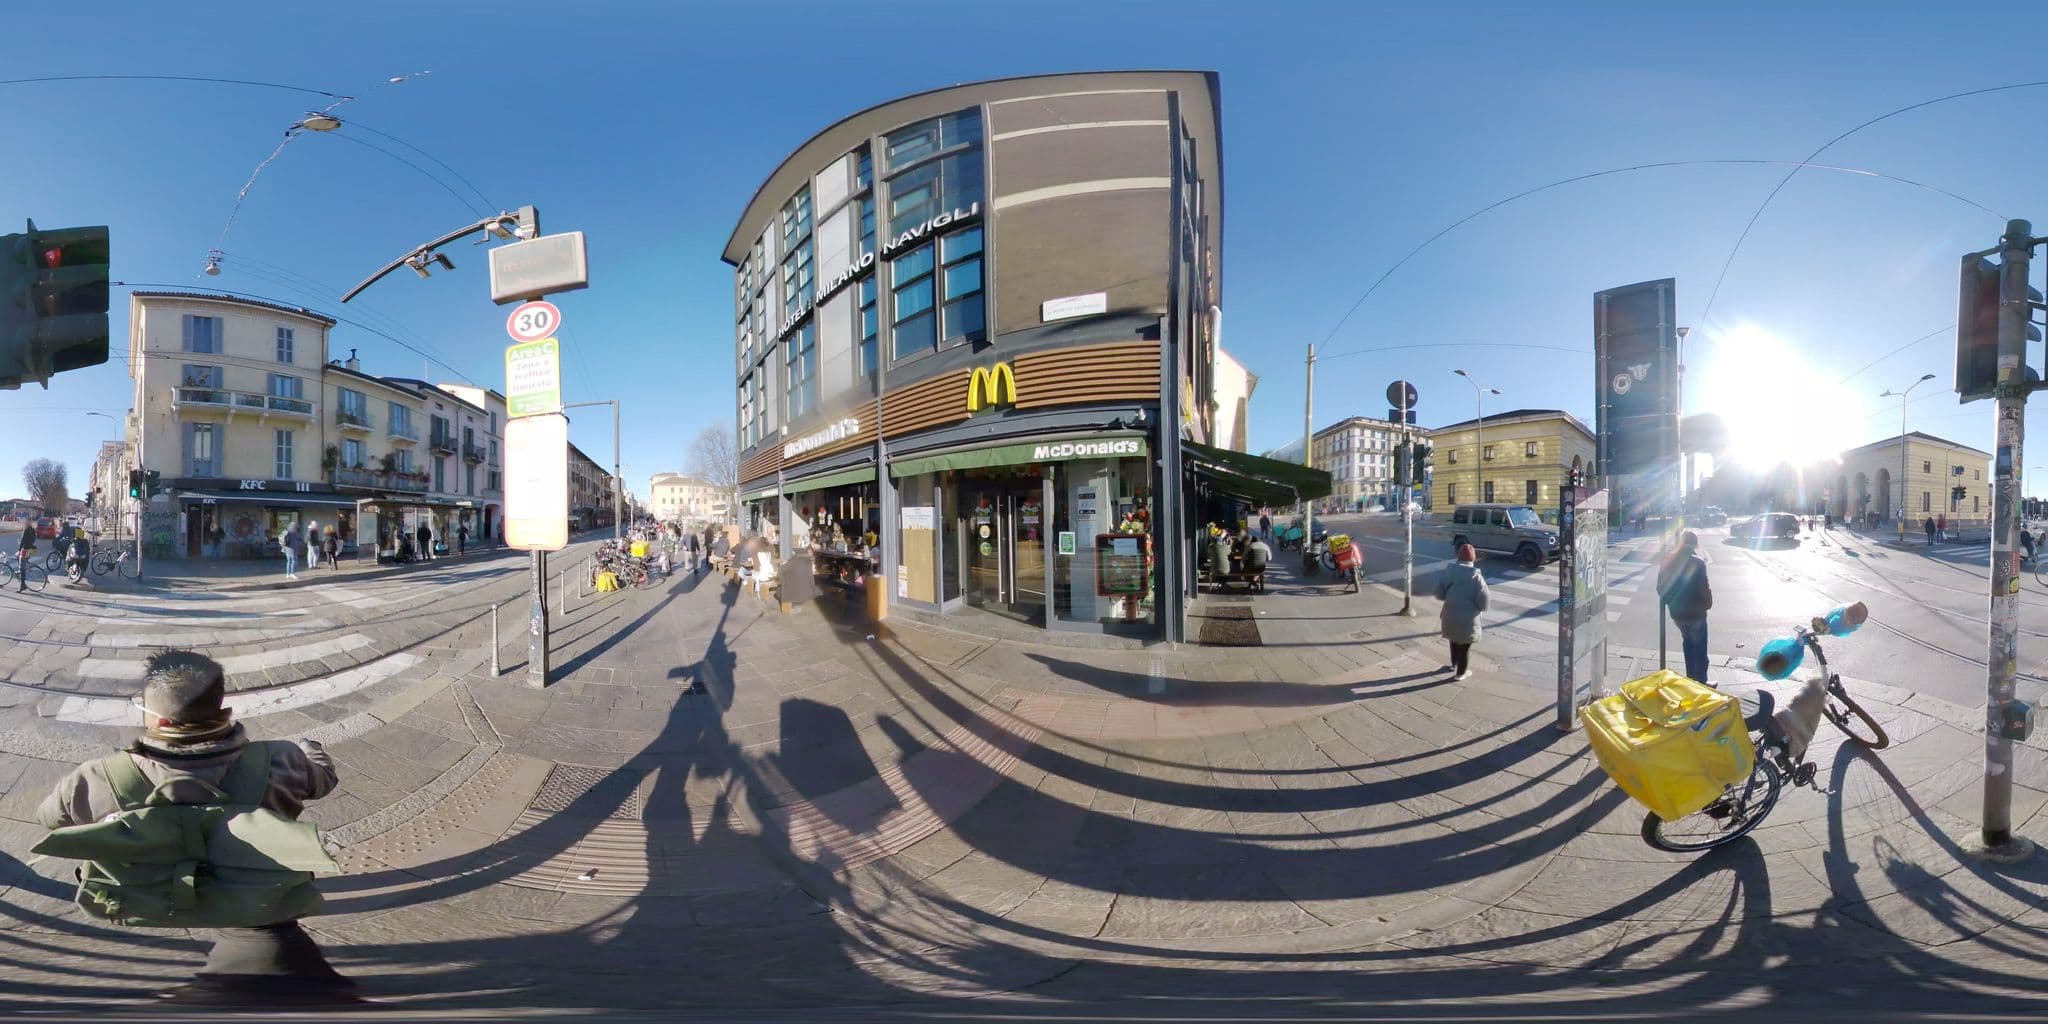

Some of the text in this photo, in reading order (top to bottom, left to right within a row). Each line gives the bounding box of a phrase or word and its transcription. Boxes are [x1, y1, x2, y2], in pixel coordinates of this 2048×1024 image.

[778, 202, 979, 338] HOTEL MILANO NAVIGLI
[520, 311, 548, 332] 30
[1034, 440, 1139, 459] McDonald's
[240, 479, 266, 490] KFC
